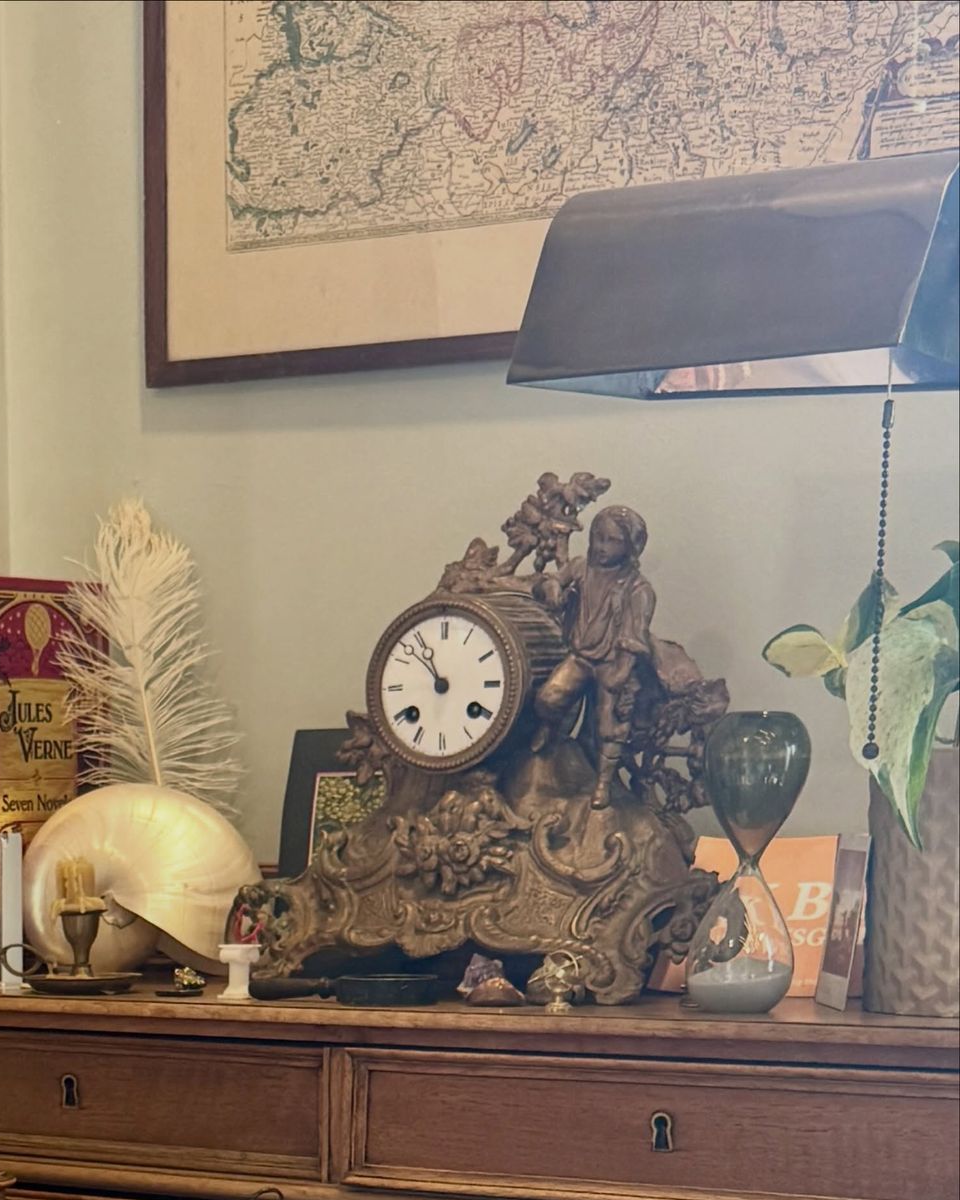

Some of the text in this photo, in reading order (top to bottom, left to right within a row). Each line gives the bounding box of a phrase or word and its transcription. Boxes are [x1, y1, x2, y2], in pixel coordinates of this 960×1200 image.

[0, 690, 53, 732] JULES
[14, 726, 74, 763] VERNE
[1, 794, 34, 813] Seven
